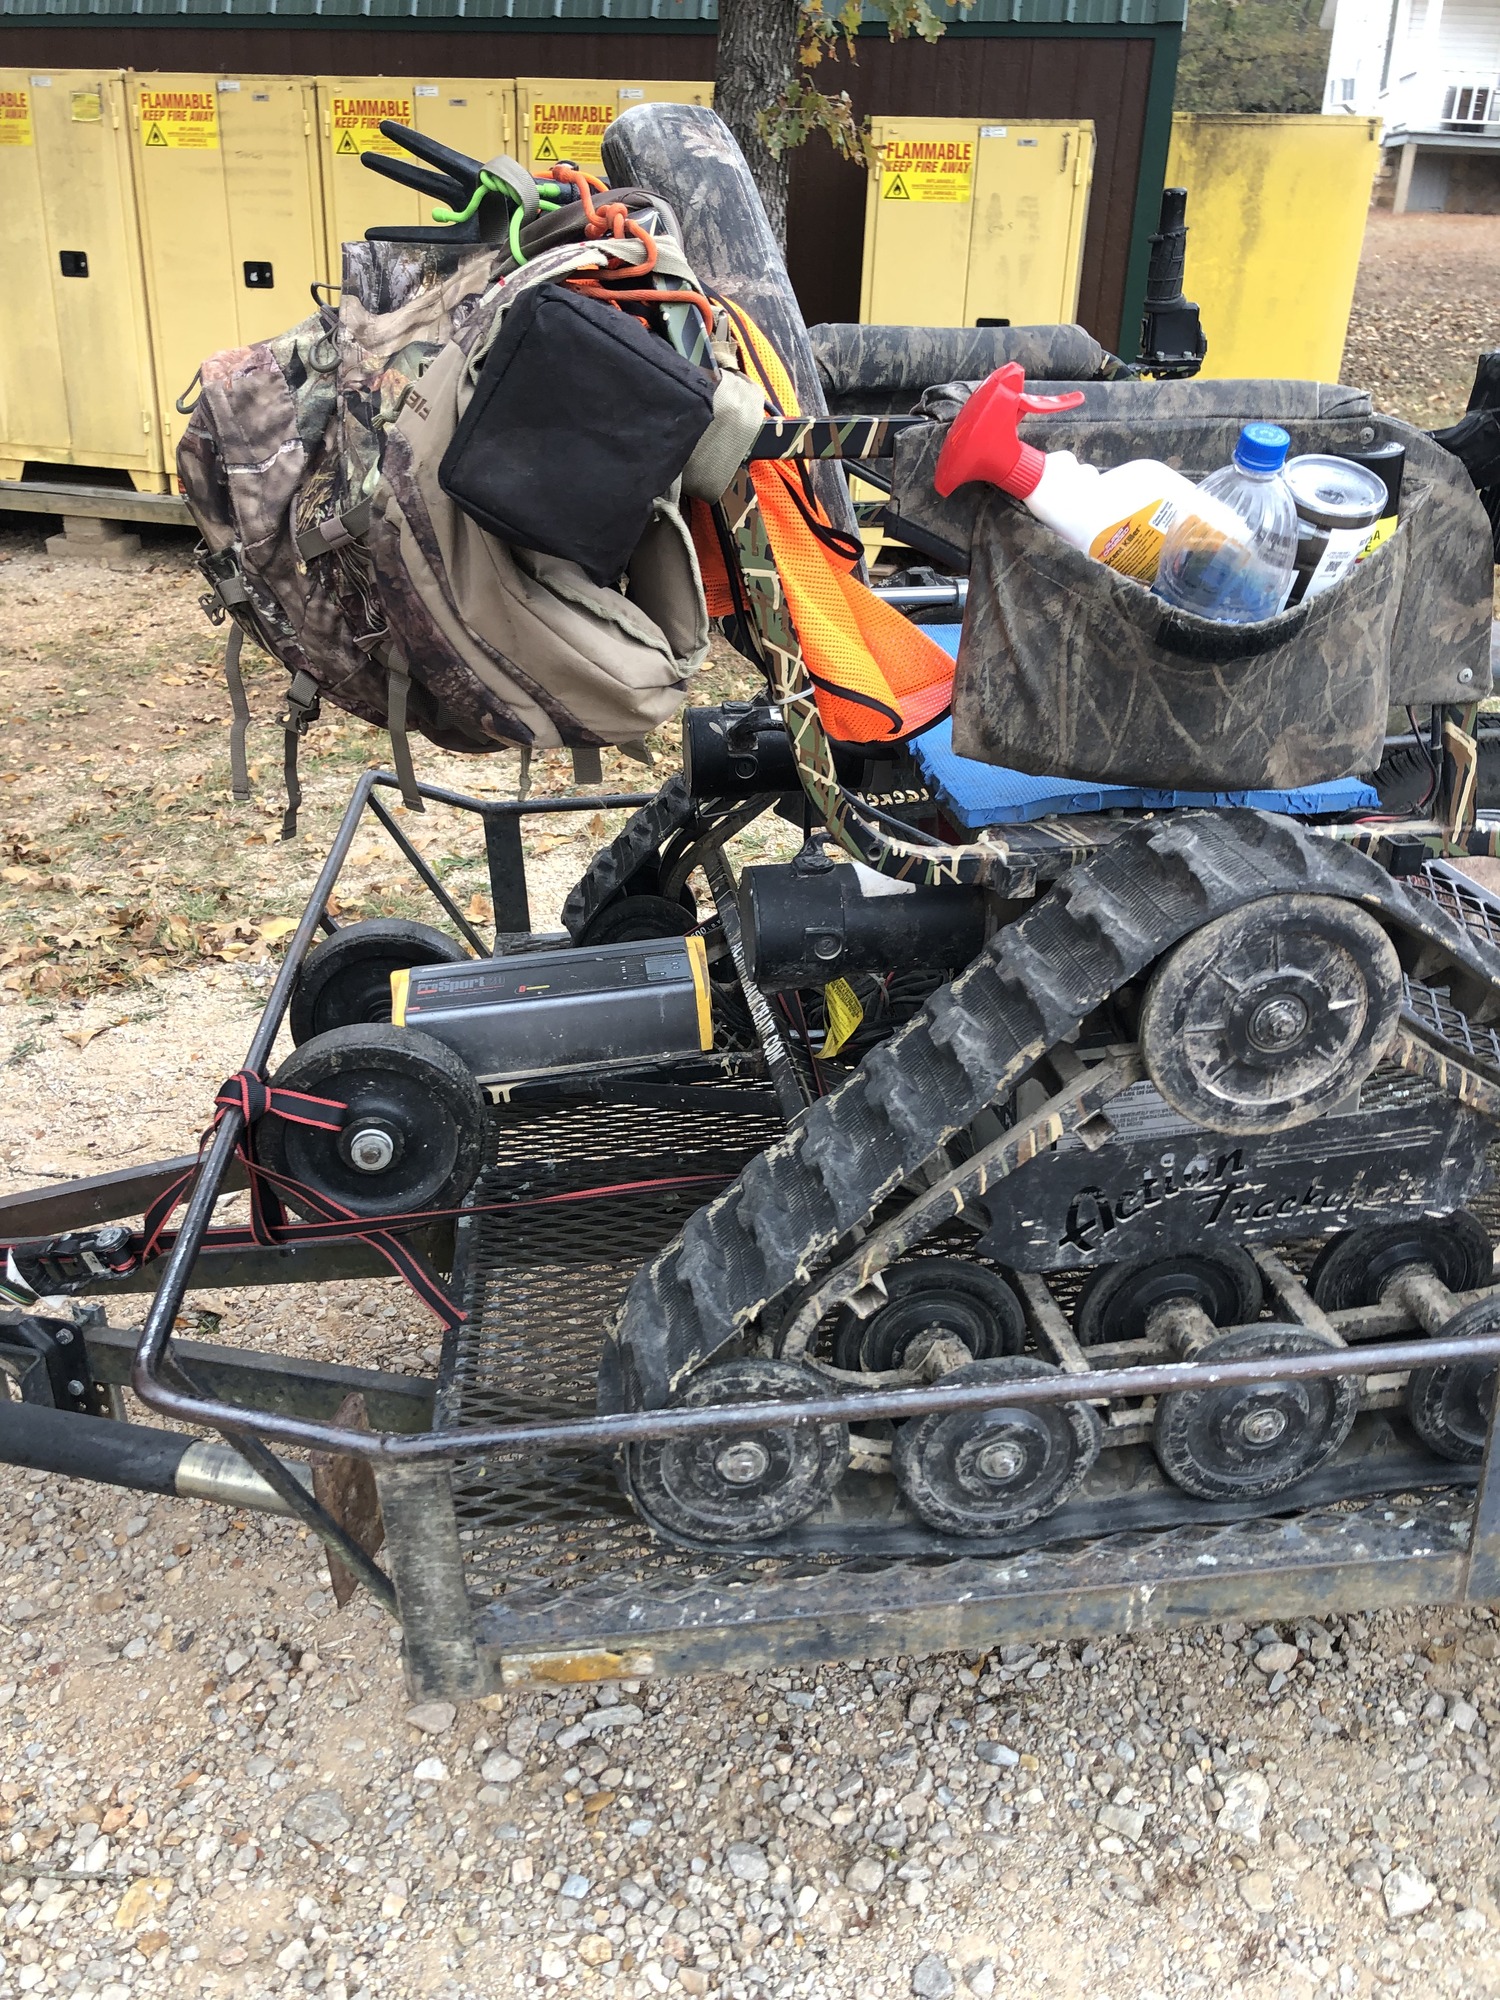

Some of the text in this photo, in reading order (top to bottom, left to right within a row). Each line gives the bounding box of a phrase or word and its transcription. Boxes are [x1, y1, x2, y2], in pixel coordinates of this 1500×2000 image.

[141, 93, 213, 109] FLAMMABLE
[333, 99, 409, 116] FLAMMABLE
[142, 110, 214, 122] KEEP FIRE AWAY
[534, 105, 613, 122] FLAMMABLE
[334, 117, 359, 128] KEEP
[534, 123, 608, 135] KEEP FIRE AWA
[886, 142, 972, 160] FLAMMABLE
[914, 161, 938, 173] FIRE
[940, 162, 971, 174] AWAY
[1104, 547, 1124, 566] Scent
[417, 976, 486, 993] ProSport
[1059, 1147, 1248, 1255] Action
